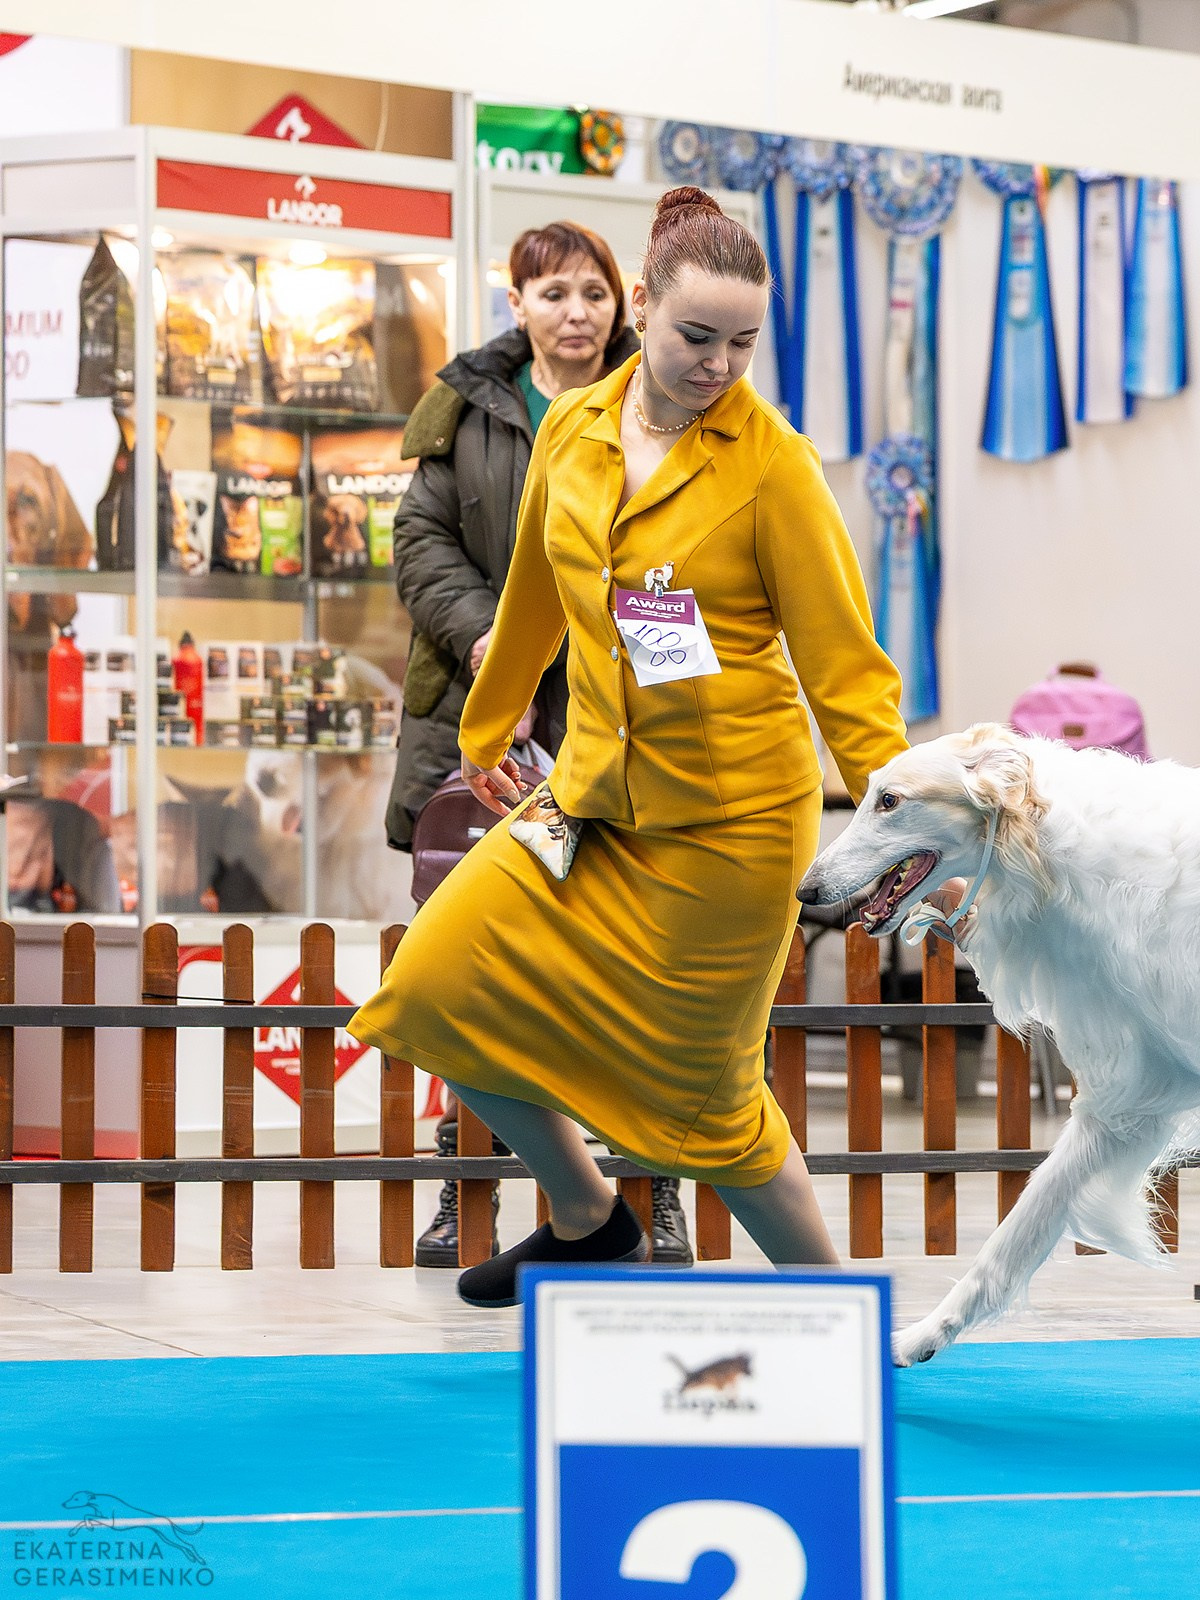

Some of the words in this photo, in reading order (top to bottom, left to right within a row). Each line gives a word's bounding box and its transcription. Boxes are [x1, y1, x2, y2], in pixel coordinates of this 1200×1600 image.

[266, 197, 343, 226] LANDOR
[226, 475, 293, 498] LANDOR
[626, 596, 686, 613] Award
